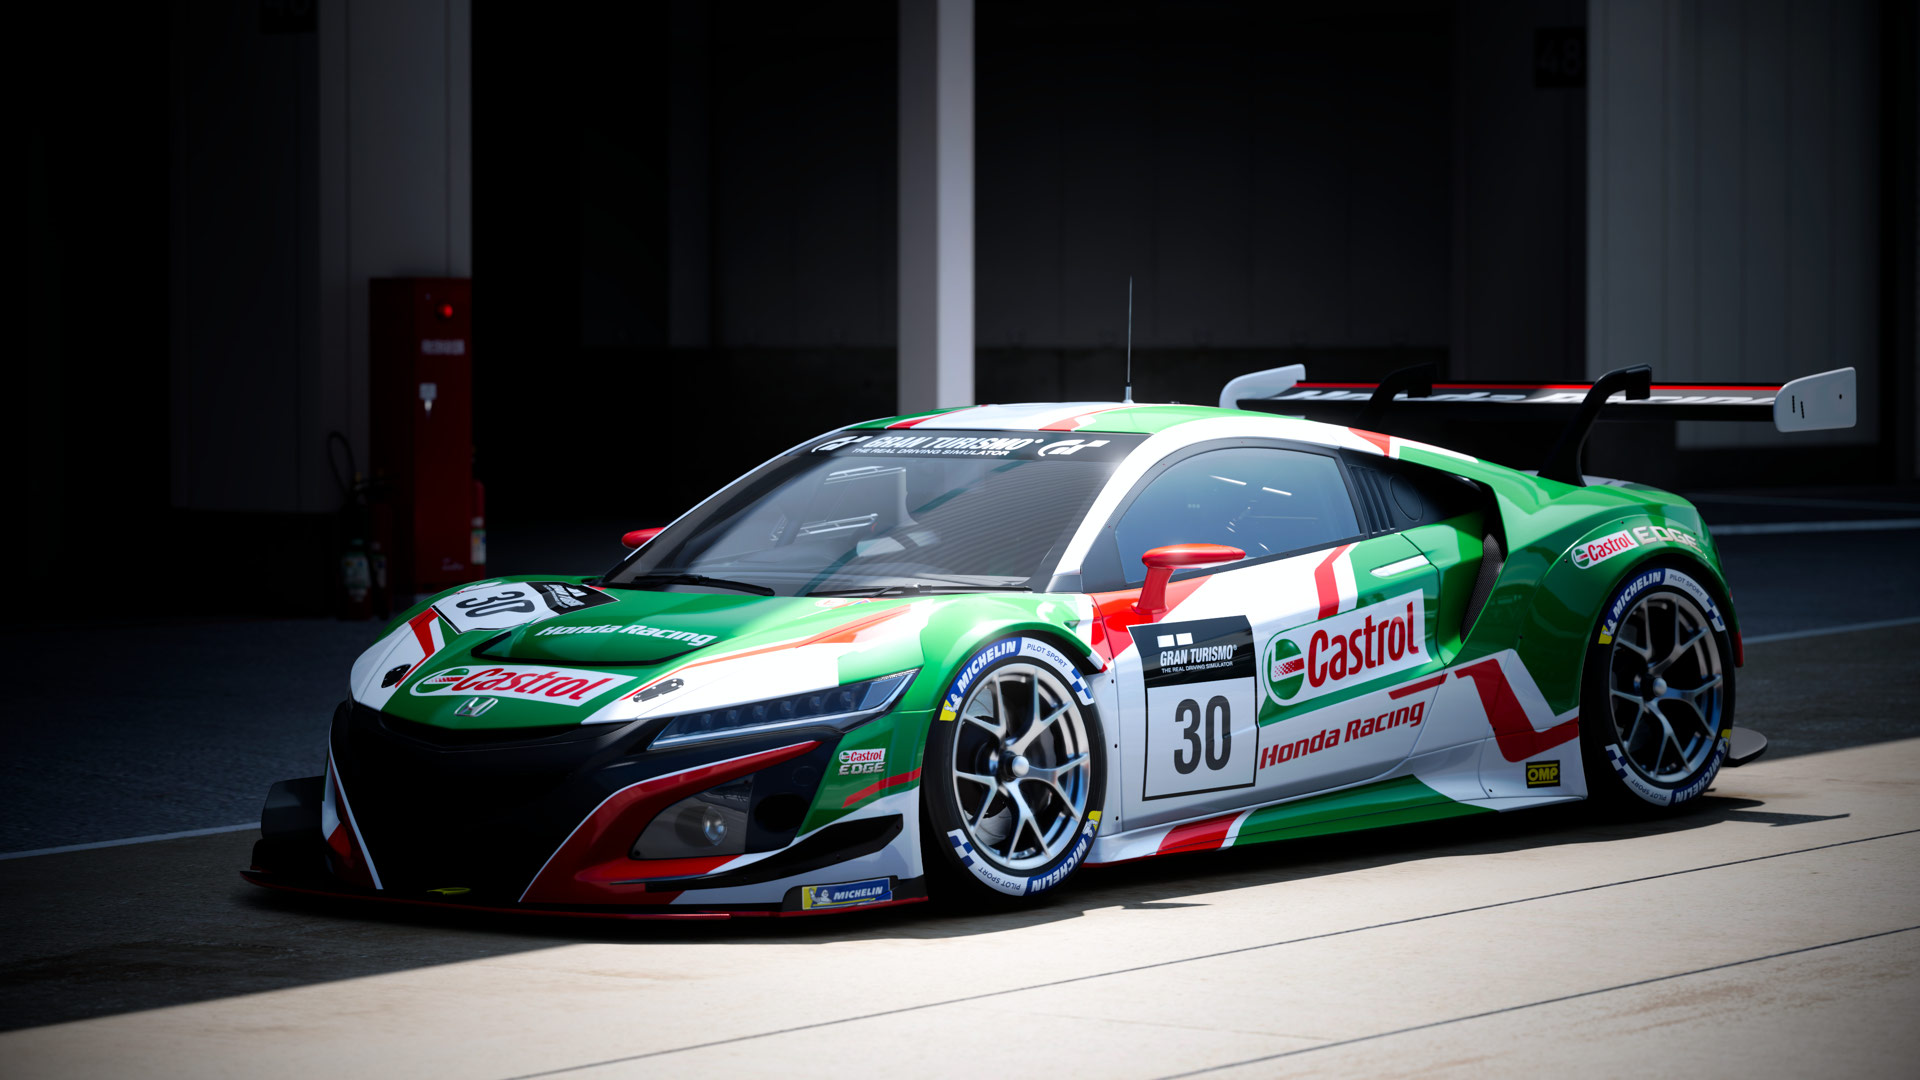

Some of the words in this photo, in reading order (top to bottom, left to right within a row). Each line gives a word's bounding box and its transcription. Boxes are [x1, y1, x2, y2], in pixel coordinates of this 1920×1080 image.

[863, 436, 933, 448] GRAN
[1588, 533, 1634, 561] Castrol
[1632, 526, 1702, 553] EDGE
[1613, 571, 1662, 619] MICHELIN
[1669, 574, 1686, 583] PILOT
[1686, 581, 1703, 597] SPORT
[456, 591, 535, 617] 30
[535, 625, 622, 636] Honda
[618, 624, 717, 646] Racing
[1308, 601, 1419, 688] Castrol
[957, 640, 1017, 693] MICHELIN
[1026, 643, 1046, 654] PILOT
[1046, 650, 1068, 668] SPORT
[1160, 649, 1188, 666] GRAN
[1206, 661, 1233, 669] SIMULATOR
[452, 668, 613, 700] Castrol
[1174, 695, 1232, 775] 30
[1259, 728, 1341, 770] Honda
[1344, 701, 1425, 743] Racing
[850, 750, 882, 762] Castrol
[839, 762, 886, 776] EDGE
[1528, 767, 1558, 781] OMP
[1674, 754, 1720, 802] MICHELIN
[978, 866, 1001, 884] SPORT
[1031, 837, 1088, 892] MICHELIN
[833, 886, 883, 900] MICHELIN
[1000, 881, 1021, 891] PILOT
